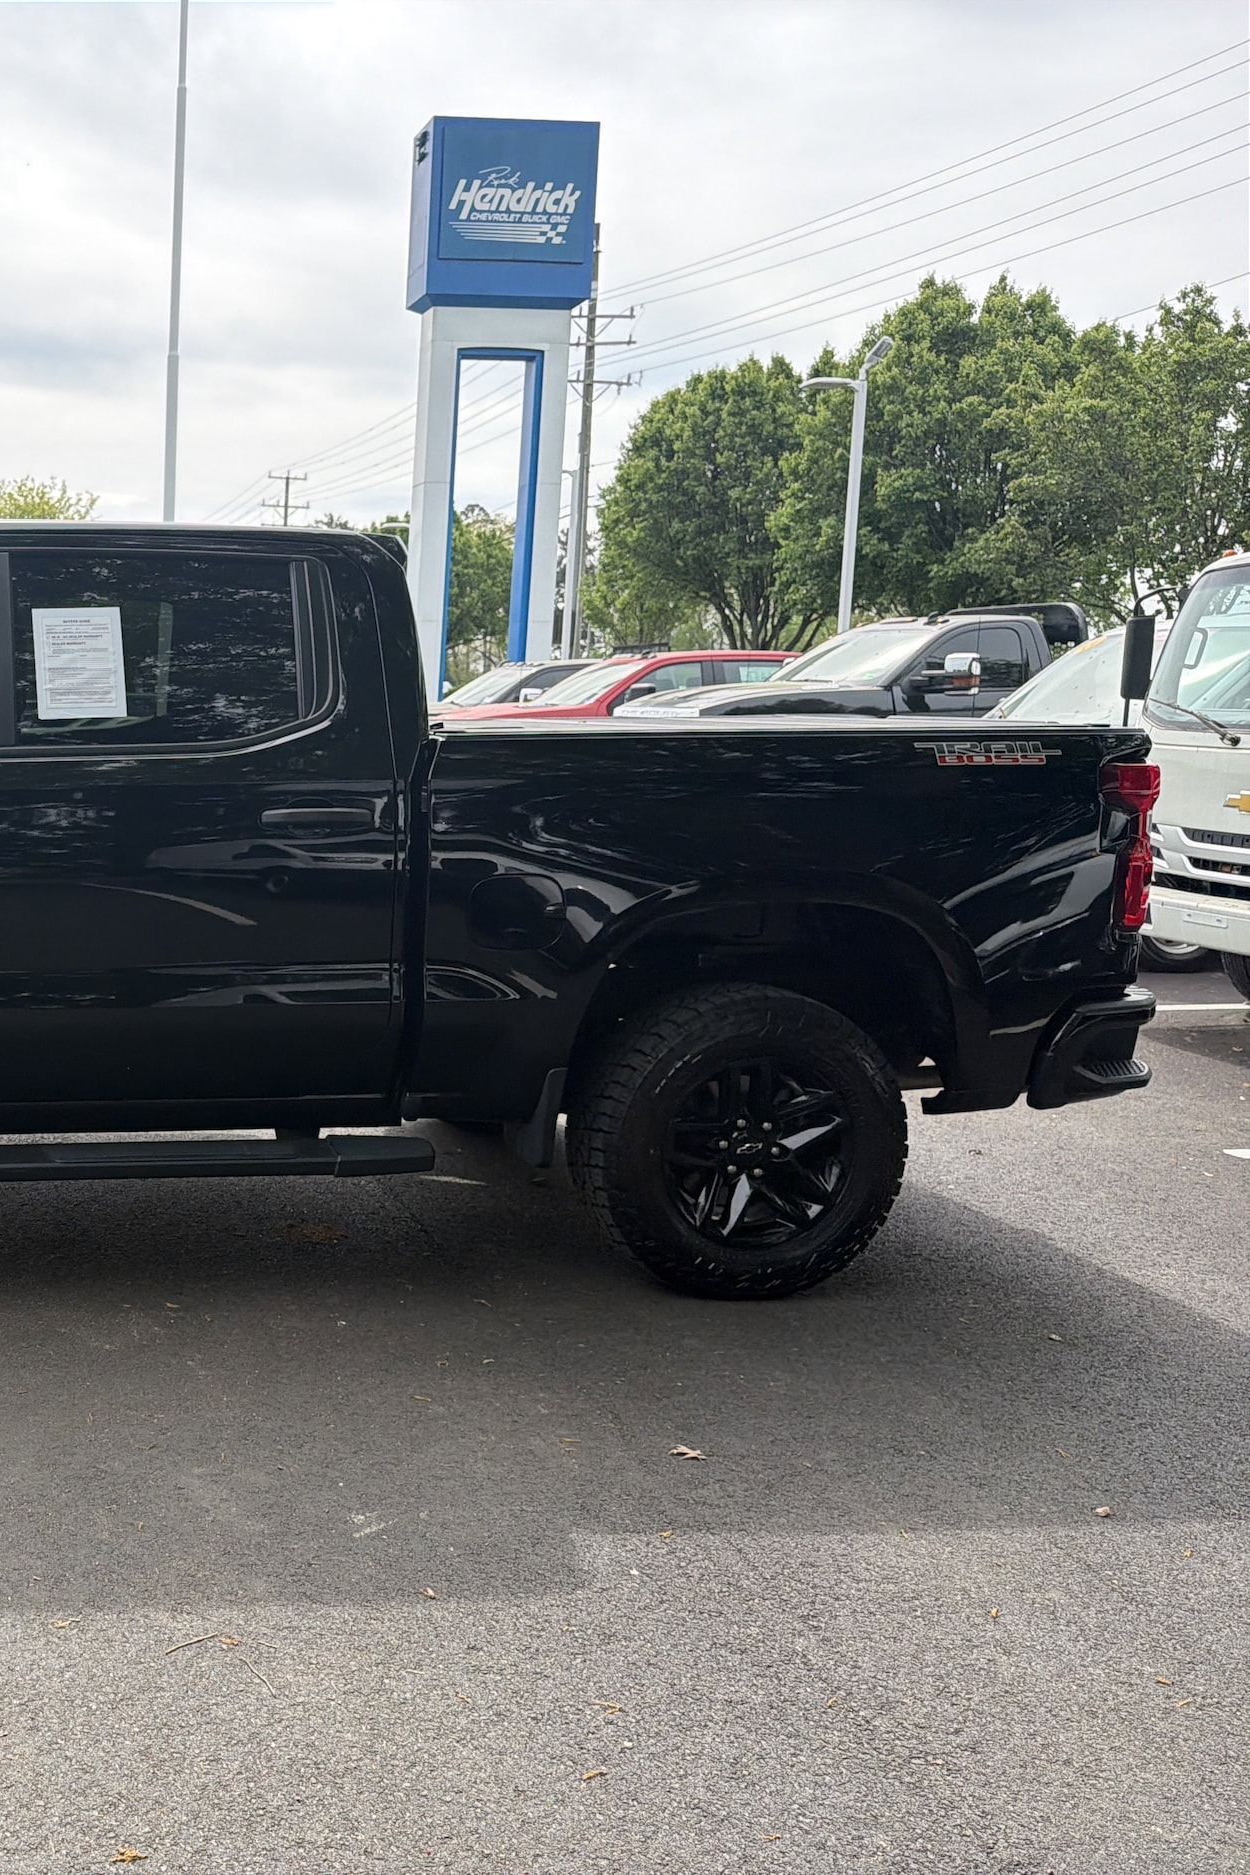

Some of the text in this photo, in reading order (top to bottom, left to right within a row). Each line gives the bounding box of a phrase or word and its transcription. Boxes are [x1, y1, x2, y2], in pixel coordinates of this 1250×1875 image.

[448, 179, 581, 220] Hendrick
[470, 211, 571, 224] CHEVROLET BUICK GMC
[913, 741, 1063, 755] TRAIL
[936, 754, 1047, 766] BOSS
